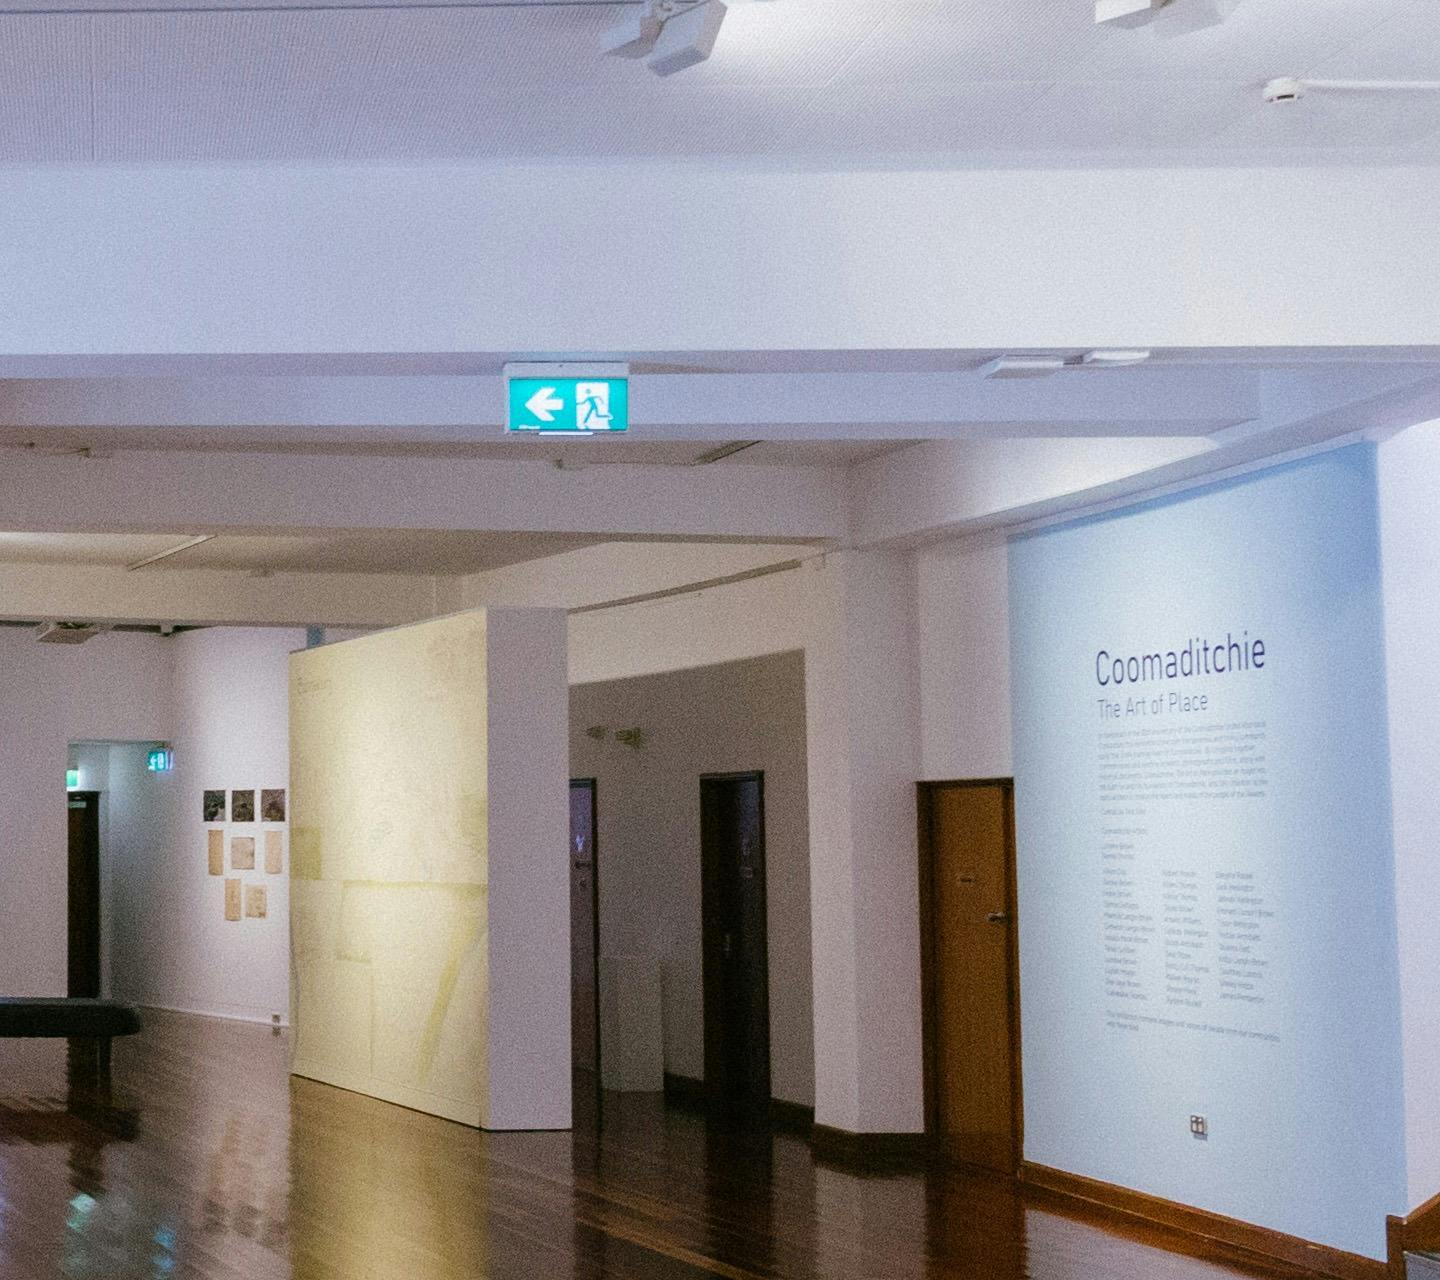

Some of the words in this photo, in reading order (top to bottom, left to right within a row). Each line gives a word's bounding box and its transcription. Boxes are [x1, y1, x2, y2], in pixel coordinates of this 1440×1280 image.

[1096, 631, 1265, 686] Coomaditchie
[1097, 699, 1120, 718] The
[1126, 697, 1146, 716] Art
[1151, 694, 1163, 715] of
[1168, 692, 1208, 712] Place
